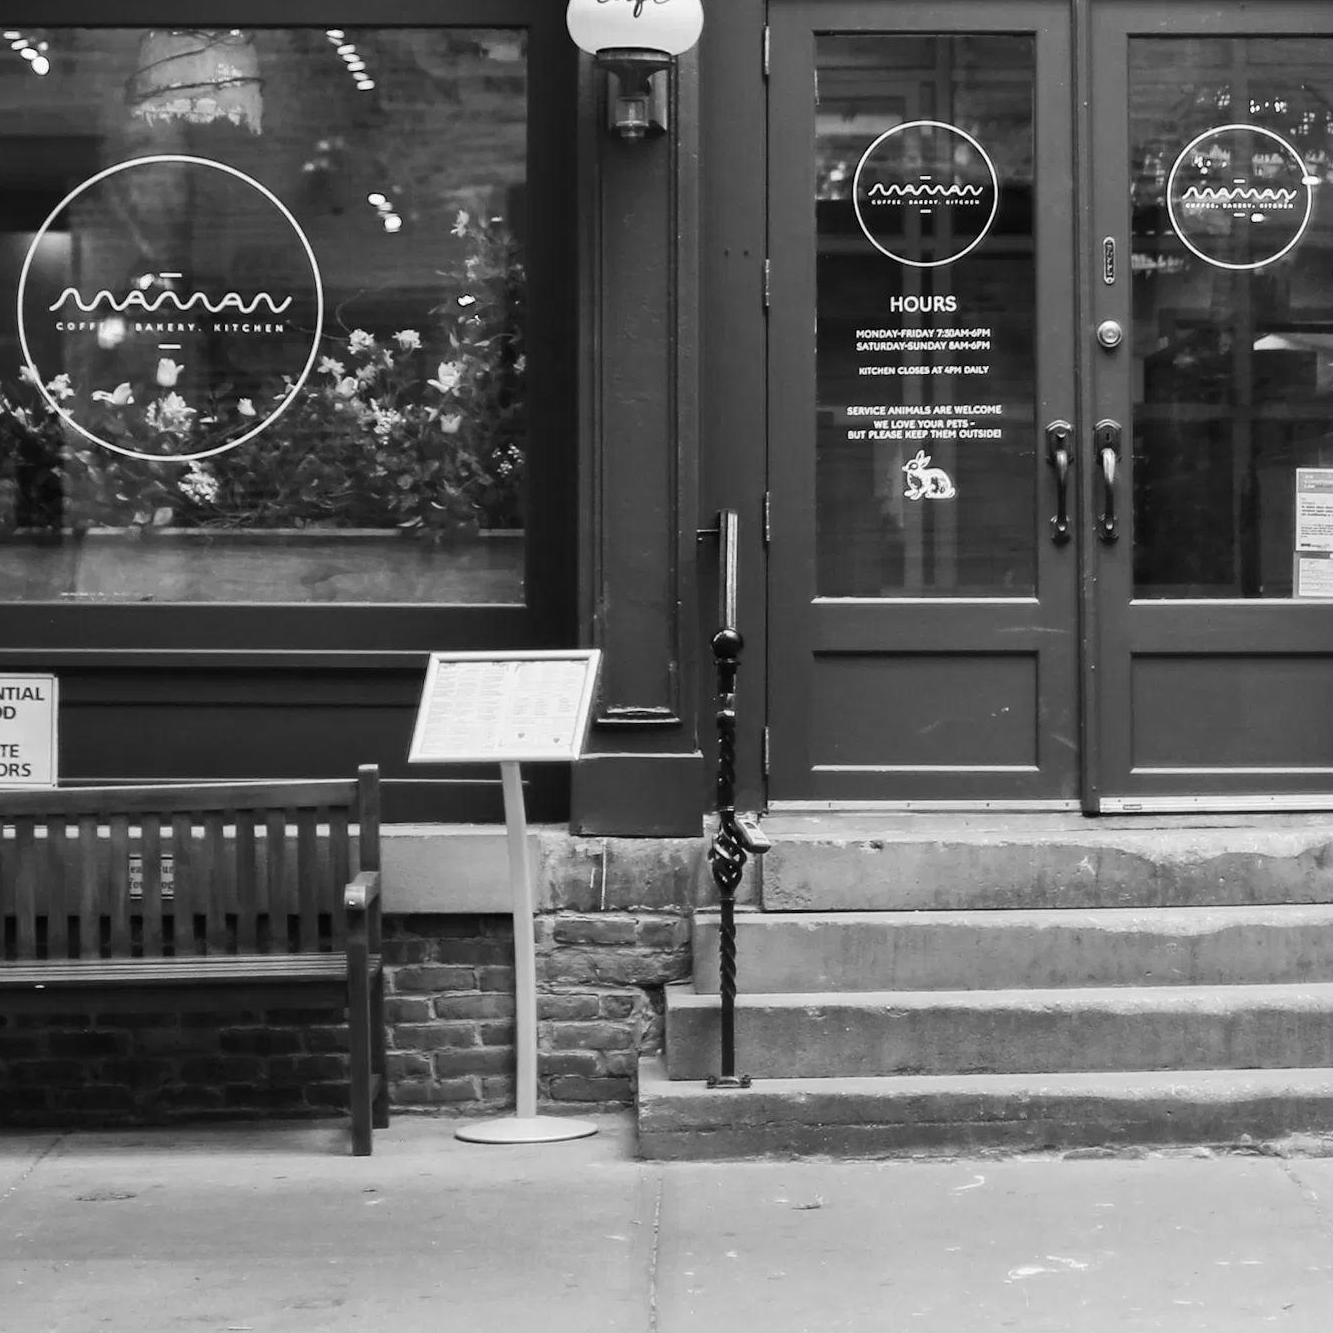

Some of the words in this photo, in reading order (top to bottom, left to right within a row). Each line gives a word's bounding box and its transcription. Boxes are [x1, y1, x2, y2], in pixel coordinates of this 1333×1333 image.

[890, 296, 957, 312] HOURS
[135, 322, 202, 332] BAKERY.
[213, 323, 284, 333] KITCHEN
[856, 329, 934, 338] MONDAY-FRIDAY
[856, 342, 947, 351] SATURDAY-SUNDAY
[858, 367, 896, 375] KITCHEN
[897, 367, 930, 375] CLOSES
[944, 366, 962, 374] 4PM
[963, 366, 989, 374] DAILY
[846, 406, 886, 416] SERVICE
[887, 406, 931, 415] ANIMALS
[933, 405, 952, 414] ARE
[954, 405, 1002, 414] WELCOME
[873, 420, 889, 429] WE
[891, 420, 916, 429] LOVE
[917, 419, 944, 428] YOUR
[946, 419, 968, 428] PETS
[848, 430, 866, 439] BUT
[868, 430, 903, 439] PLEASE
[905, 430, 928, 439] KEEP
[930, 429, 957, 439] THEM
